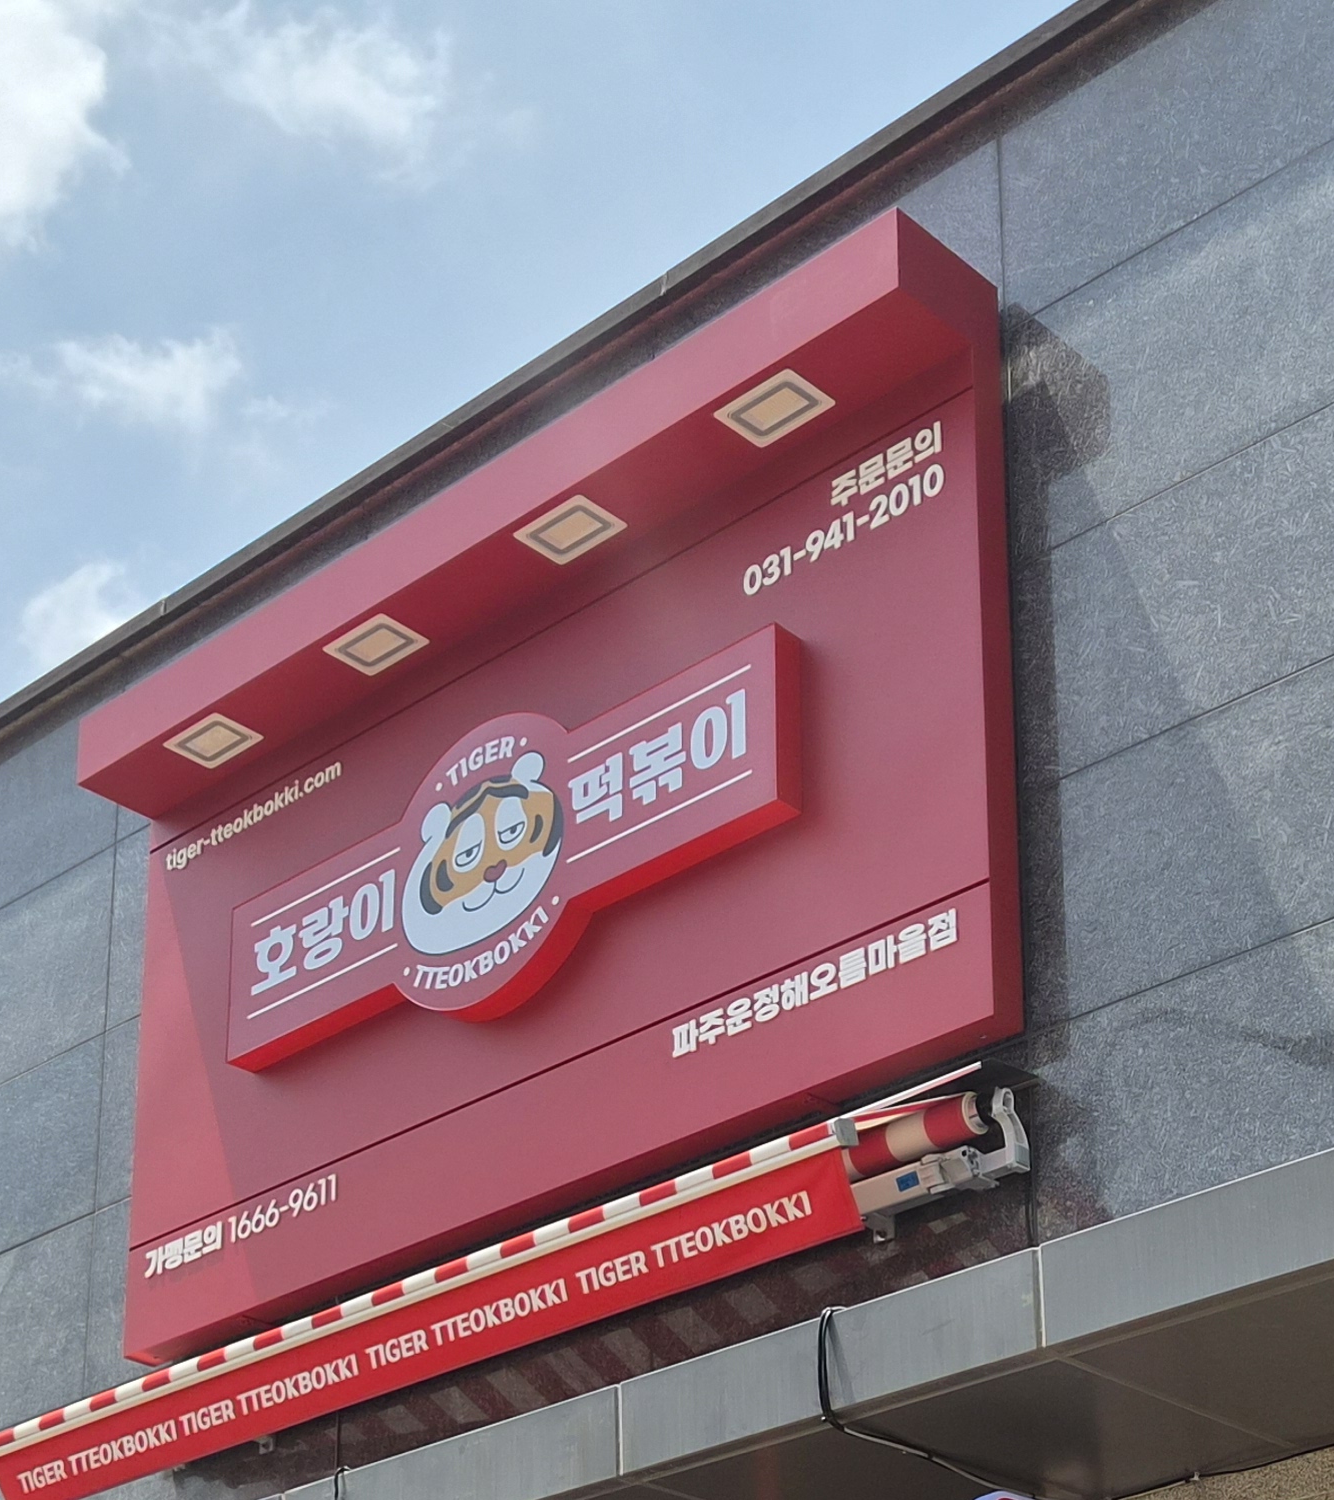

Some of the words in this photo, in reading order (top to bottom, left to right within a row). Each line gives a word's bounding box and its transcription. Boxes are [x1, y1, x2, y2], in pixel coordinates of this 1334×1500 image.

[830, 421, 942, 507] 주문문의
[742, 464, 945, 596] 031-941-2010
[166, 760, 343, 871] tiger-tteokbokki.com
[446, 735, 515, 786] TIGER
[250, 869, 396, 996] 호랑이
[568, 688, 747, 823] 떡볶이
[412, 908, 549, 990] TTEOKBOKKI
[671, 908, 958, 1058] 파주운정해오름마을점
[143, 1219, 223, 1278] 가맹문의
[226, 1173, 338, 1246] 1666-9611
[16, 1460, 67, 1495] TIGER
[68, 1417, 178, 1476] TTEOKBOKKI
[178, 1398, 236, 1436] TIGER
[237, 1353, 360, 1420] TTEOKBOKKI
[365, 1329, 430, 1371] TIGER
[431, 1278, 568, 1353] TTEOKBOKKI
[575, 1247, 649, 1296] TIGER
[652, 1190, 812, 1274] TTEOKBOKKI
